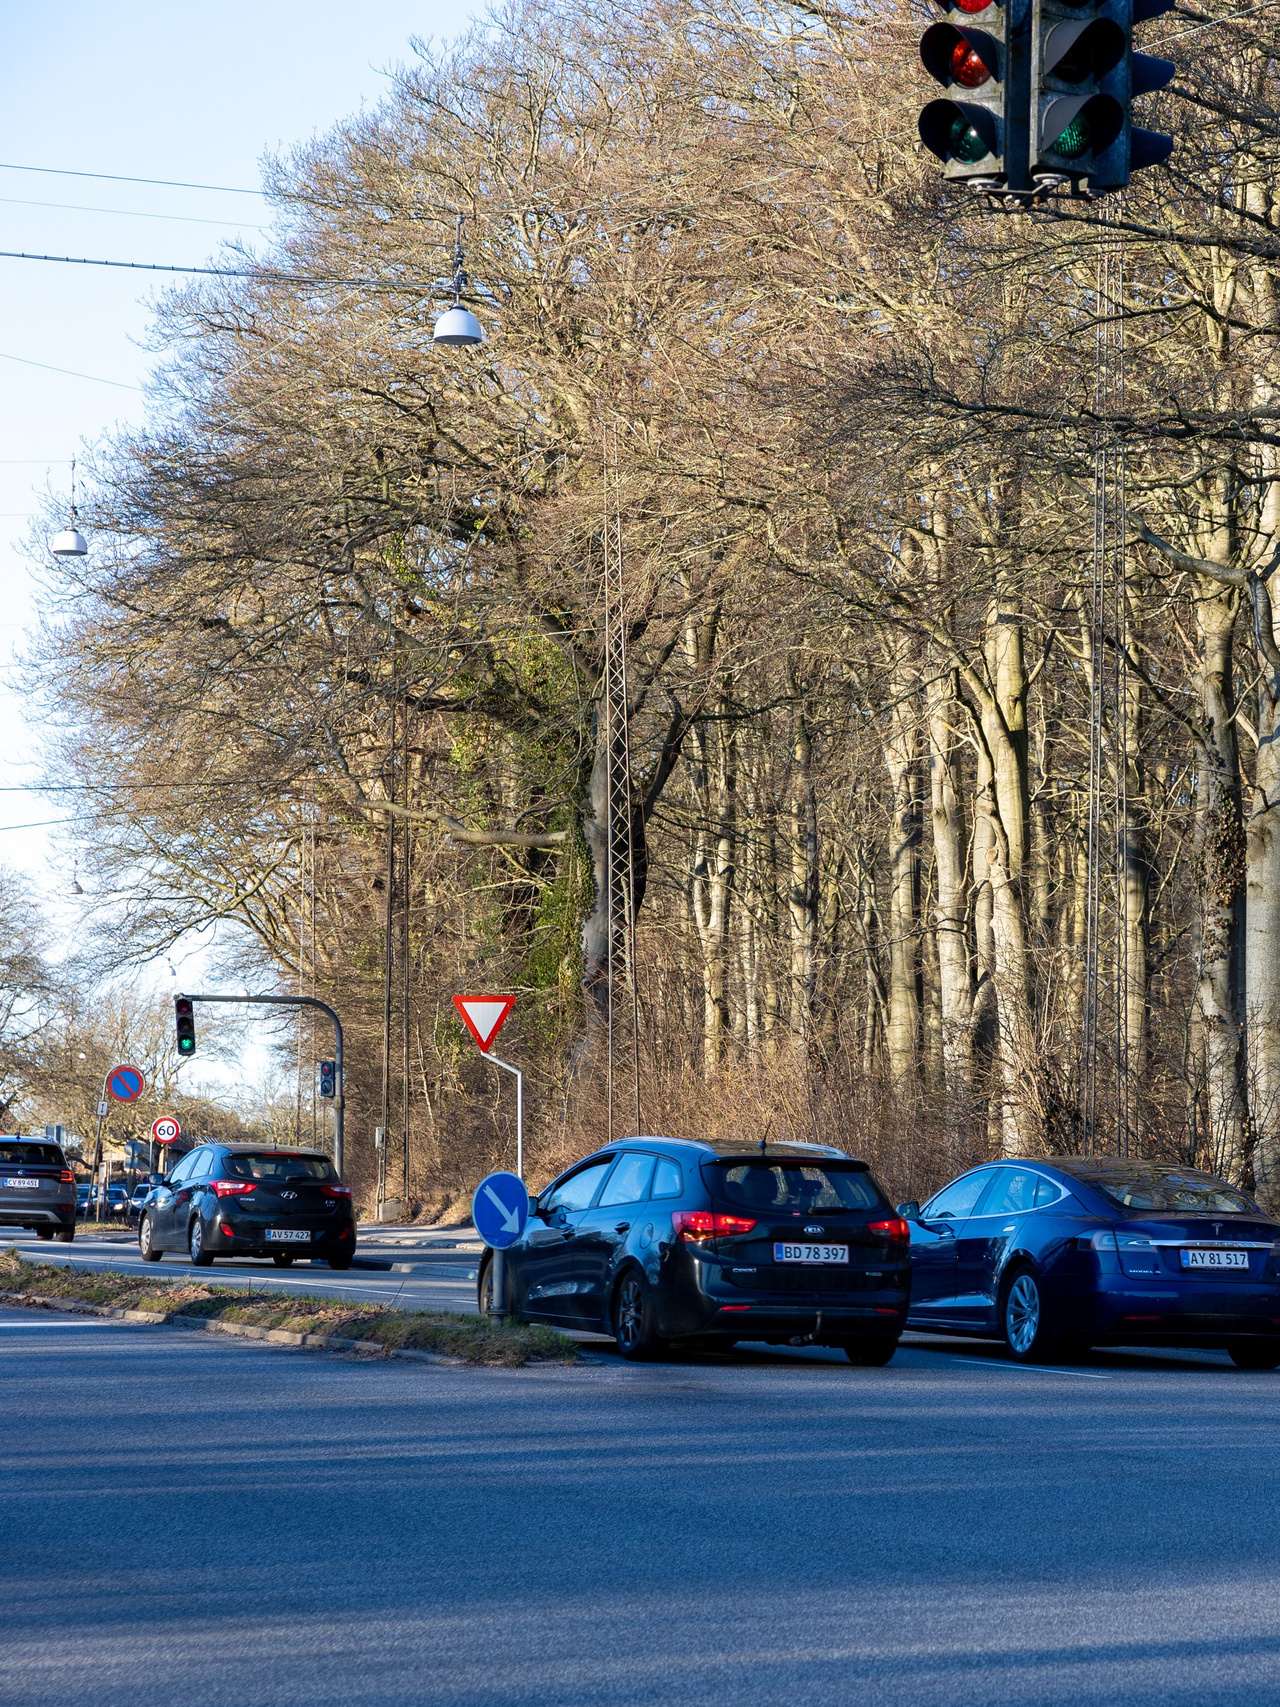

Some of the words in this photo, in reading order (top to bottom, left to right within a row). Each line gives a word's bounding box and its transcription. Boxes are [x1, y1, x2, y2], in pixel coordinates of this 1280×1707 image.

[158, 1125, 175, 1136] 60
[17, 1179, 26, 1187] 89
[272, 1231, 283, 1239] AV
[284, 1231, 294, 1239] 57
[295, 1231, 309, 1239] 427
[807, 1227, 823, 1235] KIA
[784, 1246, 802, 1259] BD
[804, 1246, 821, 1260] 78
[823, 1247, 846, 1260] 397
[1191, 1252, 1206, 1265] AY
[1208, 1252, 1222, 1265] 81
[1226, 1253, 1247, 1265] 517
